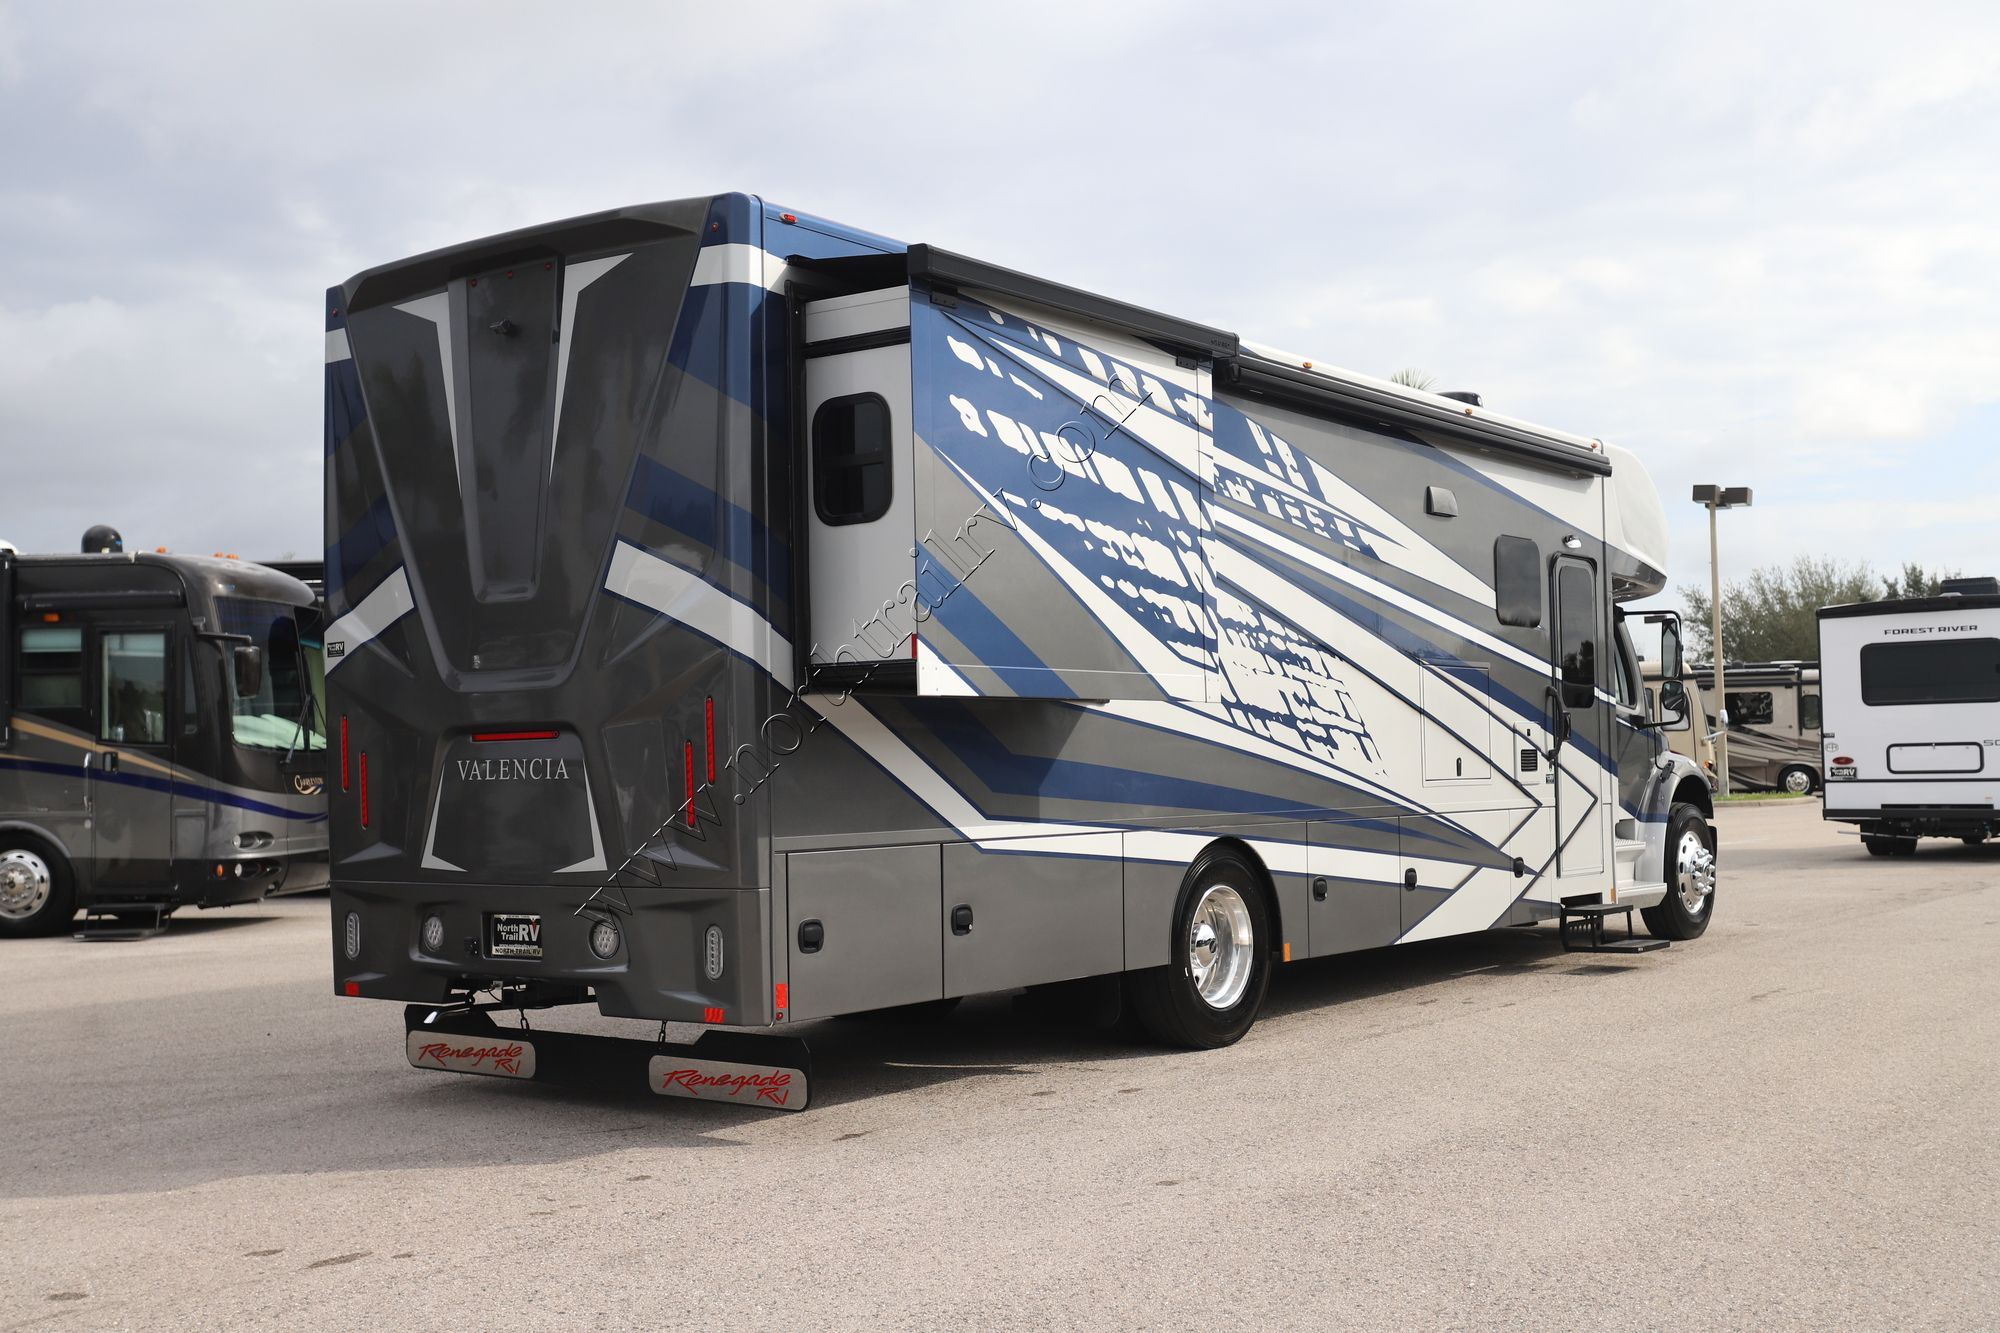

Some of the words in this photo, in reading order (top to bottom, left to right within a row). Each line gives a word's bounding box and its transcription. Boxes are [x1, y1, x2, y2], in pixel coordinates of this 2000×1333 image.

[1884, 627, 1935, 636] FOREST
[1938, 624, 1978, 633] RIVER
[456, 757, 570, 781] VALENCIA
[497, 923, 518, 932] North
[501, 932, 518, 941] Trail
[518, 924, 540, 942] RV
[418, 1042, 523, 1067] Renegade
[494, 1058, 521, 1075] RV
[662, 1069, 792, 1096] Renegade
[756, 1087, 789, 1106] RV
